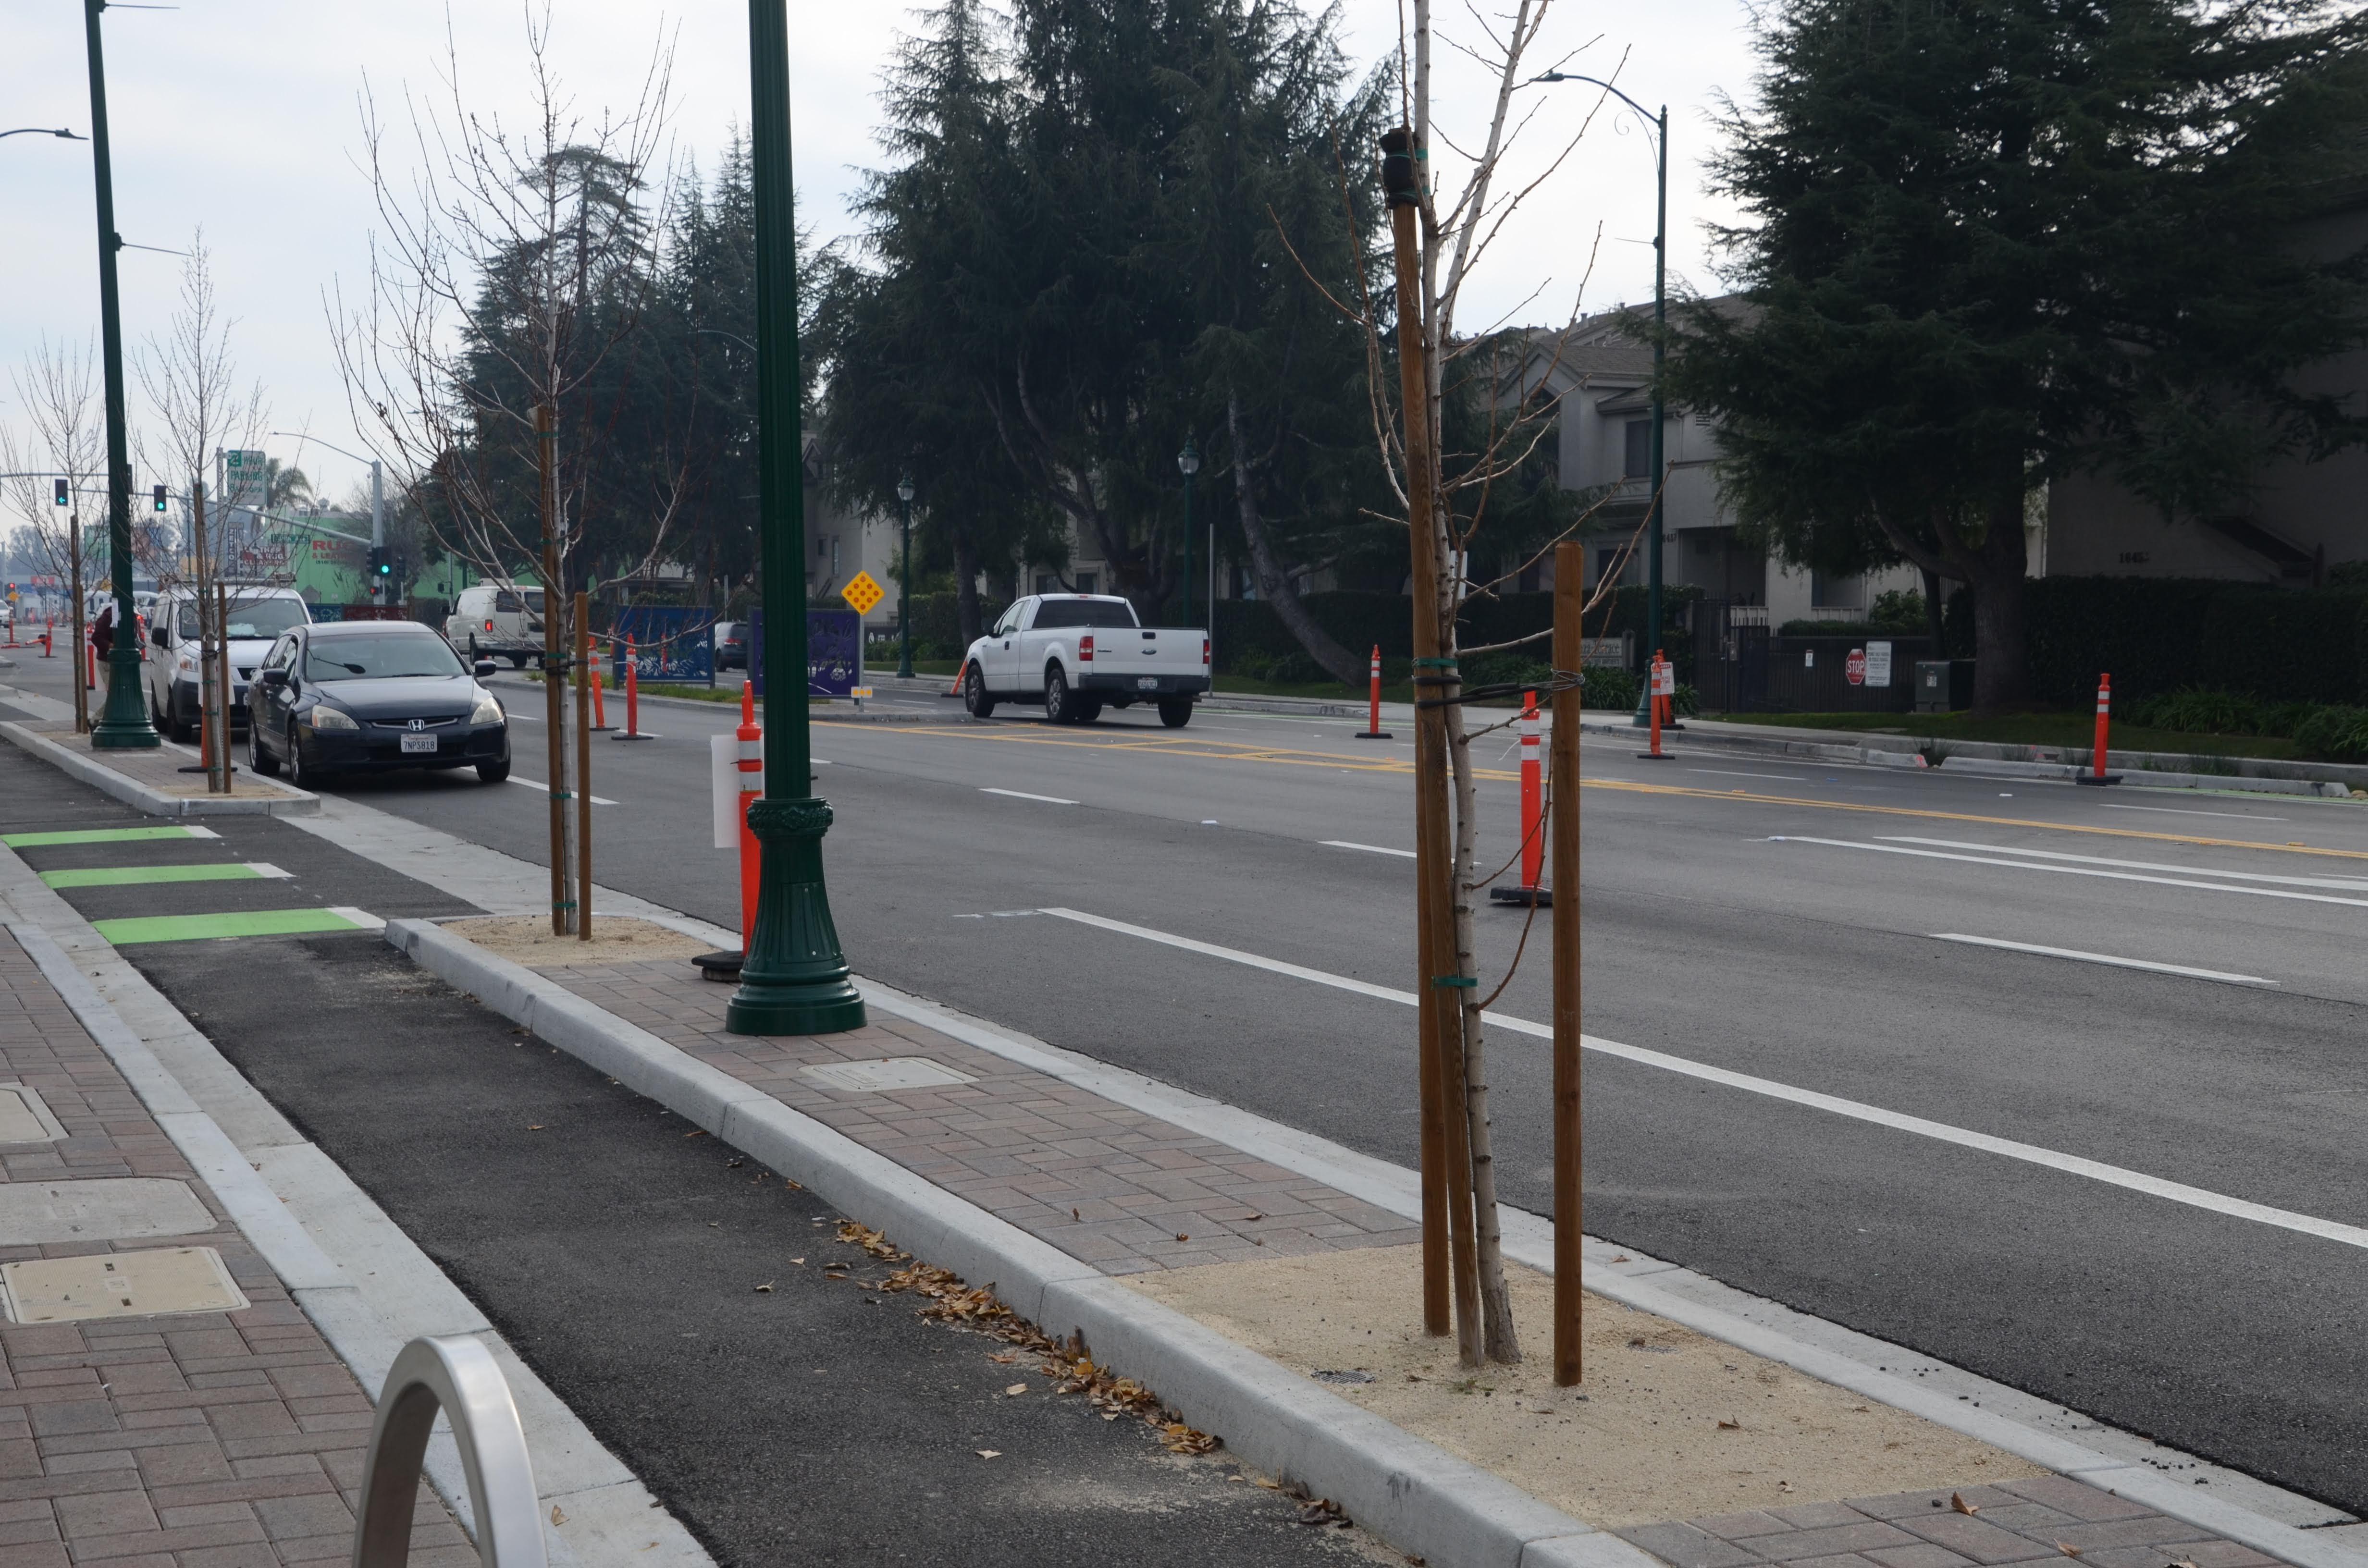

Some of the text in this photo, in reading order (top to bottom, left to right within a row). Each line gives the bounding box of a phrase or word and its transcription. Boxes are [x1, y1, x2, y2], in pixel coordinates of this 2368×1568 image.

[230, 471, 263, 481] PARKING
[1847, 660, 1865, 674] STOP
[403, 741, 435, 750] 7NPS818
